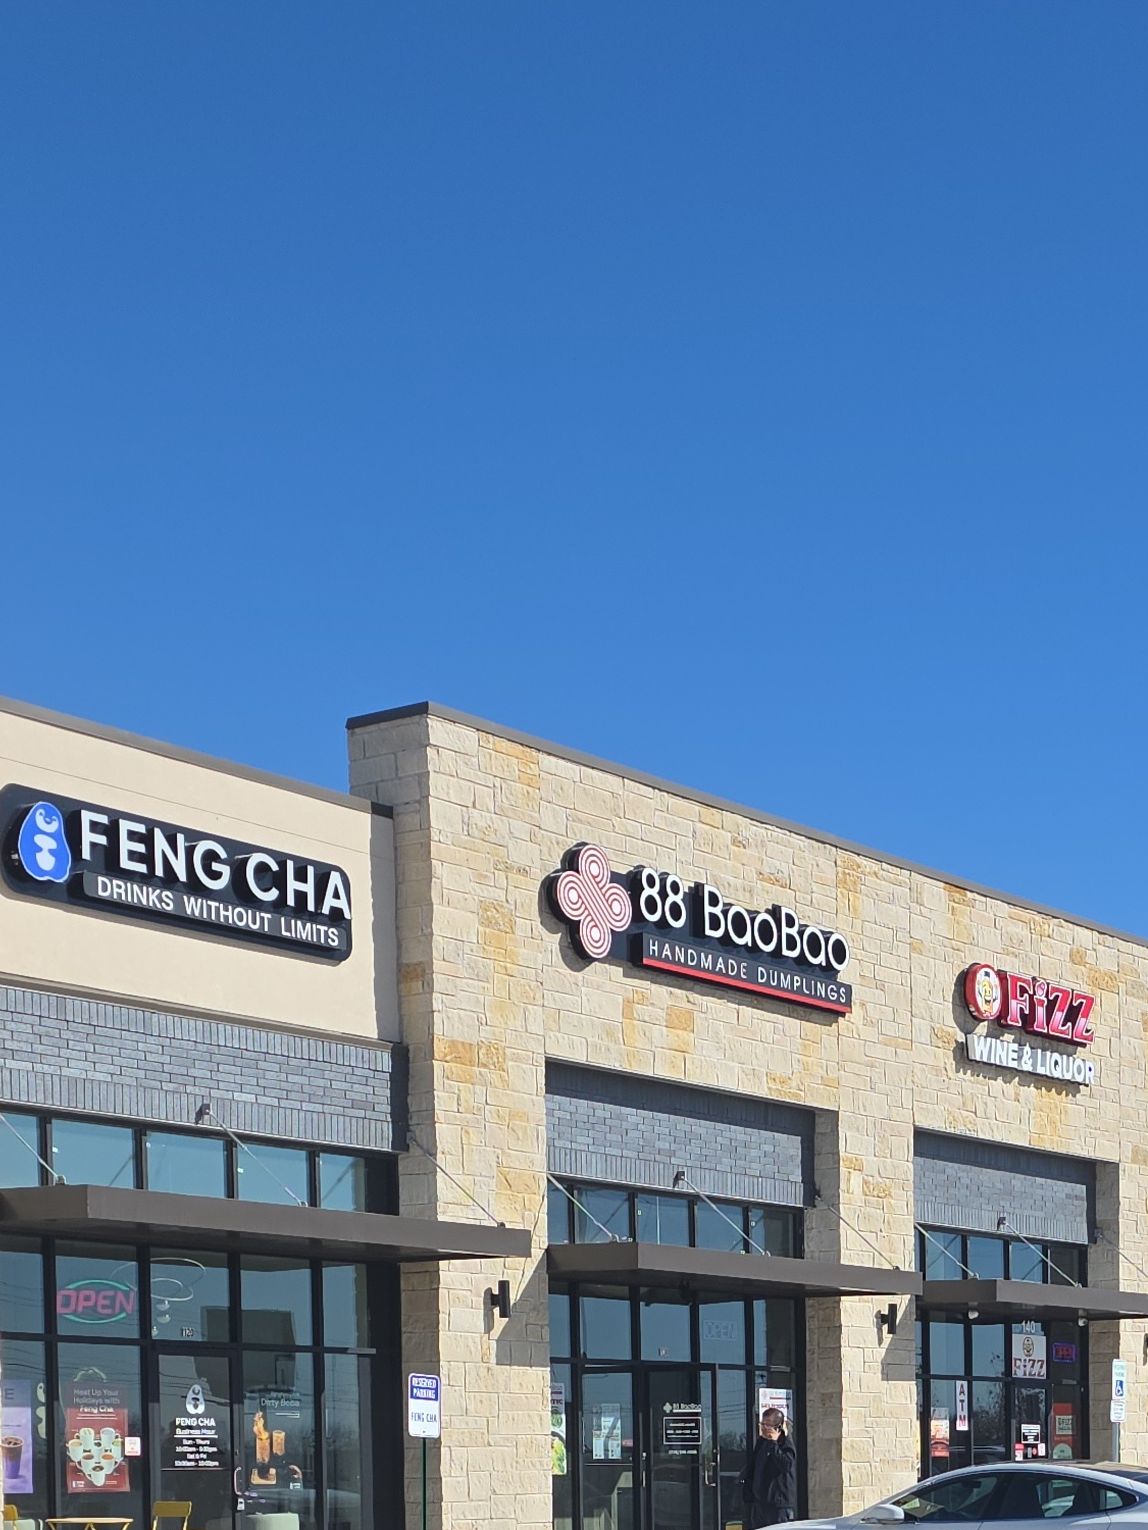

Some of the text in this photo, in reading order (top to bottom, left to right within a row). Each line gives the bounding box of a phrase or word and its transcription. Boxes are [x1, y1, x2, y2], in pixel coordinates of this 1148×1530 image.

[80, 809, 352, 920] FENG CHA
[98, 876, 339, 947] DRINKS WITHOUT LIMITS
[640, 867, 850, 971] 88 BaoBao
[649, 938, 847, 1002] HANDMADE DUMPLINGS
[973, 1035, 1095, 1084] WINE & LIQUOR
[57, 1290, 135, 1315] OPEN
[1022, 1320, 1035, 1333] 140
[413, 1388, 436, 1399] PARKING
[958, 1383, 966, 1427] ATM
[198, 1418, 216, 1426] CHA
[411, 1411, 437, 1423] FENG CHA
